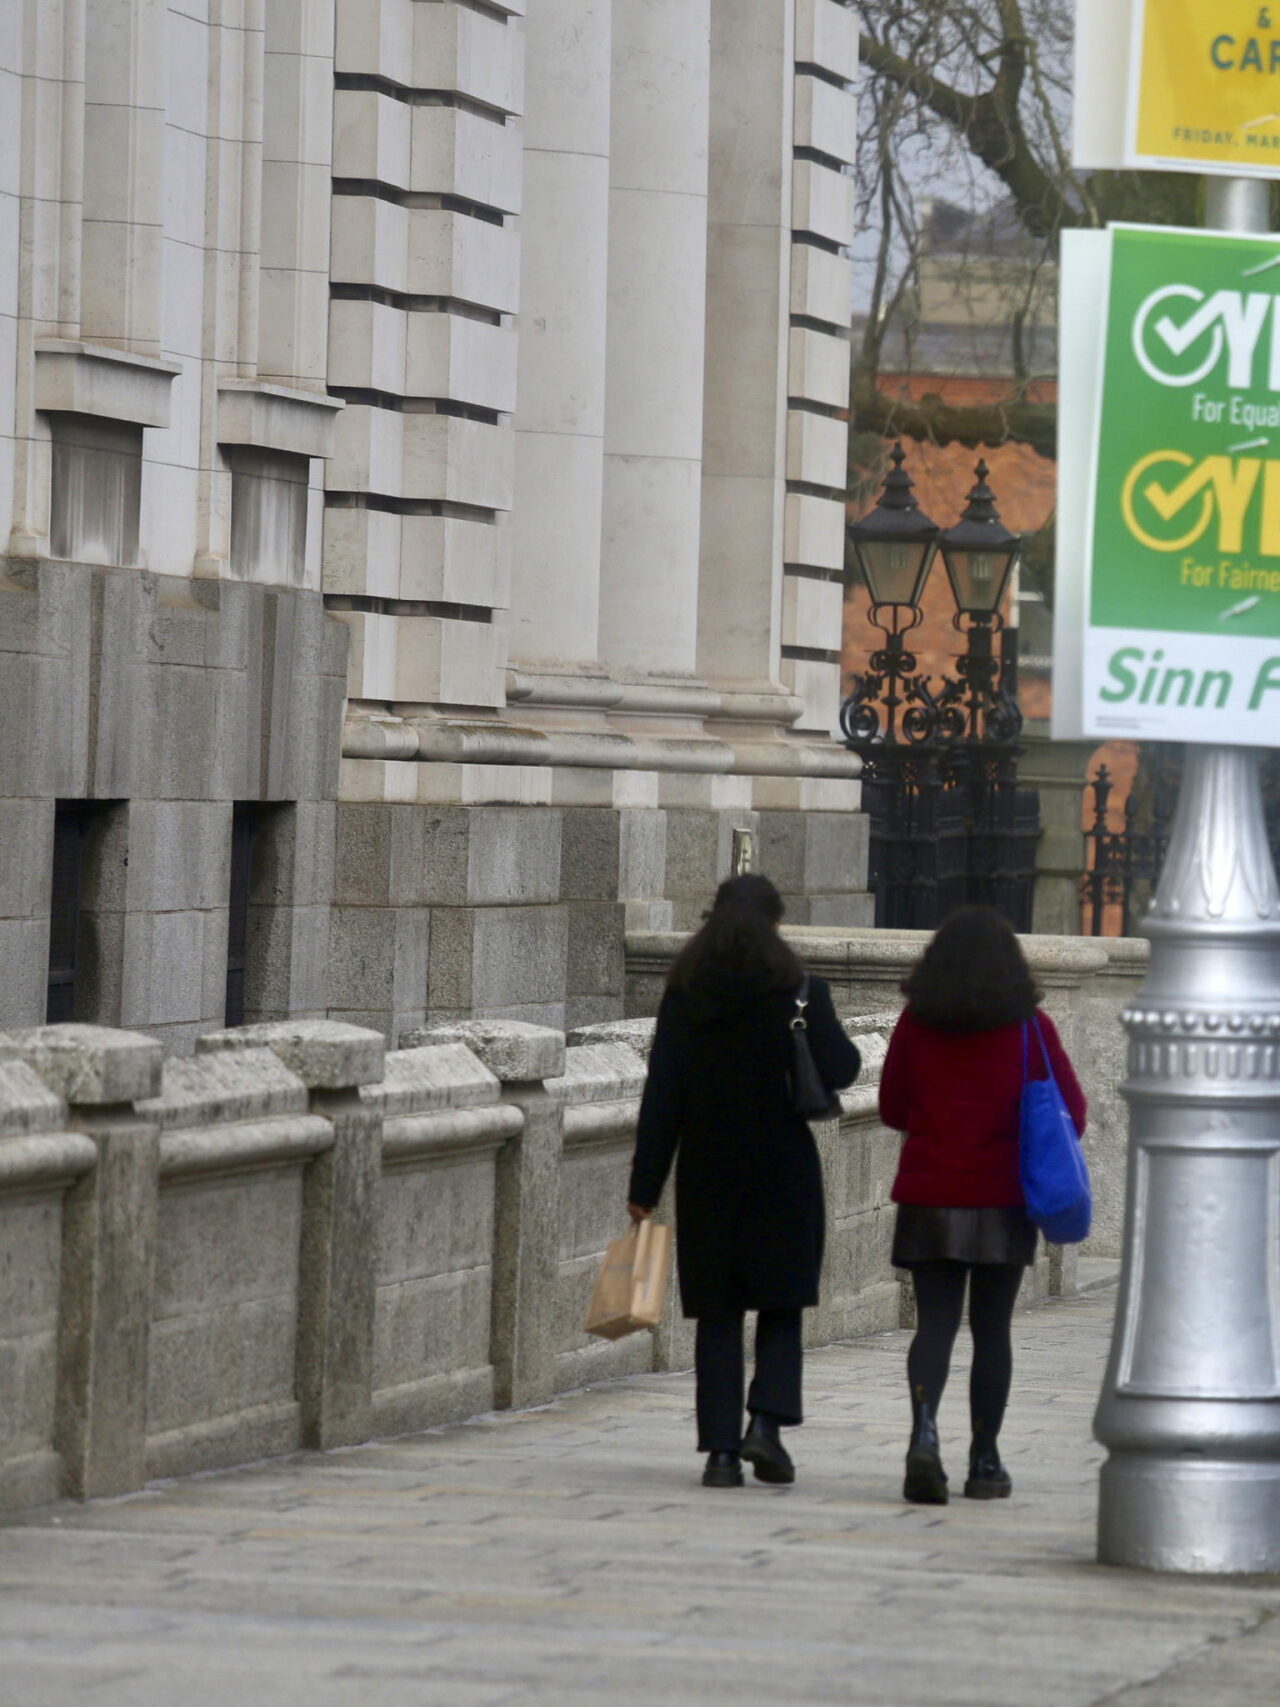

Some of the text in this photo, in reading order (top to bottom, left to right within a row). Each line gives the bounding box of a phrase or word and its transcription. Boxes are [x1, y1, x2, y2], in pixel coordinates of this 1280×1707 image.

[1257, 7, 1272, 28] &
[1192, 392, 1225, 423] For
[1180, 557, 1212, 587] For
[1097, 646, 1233, 709] Sinn
